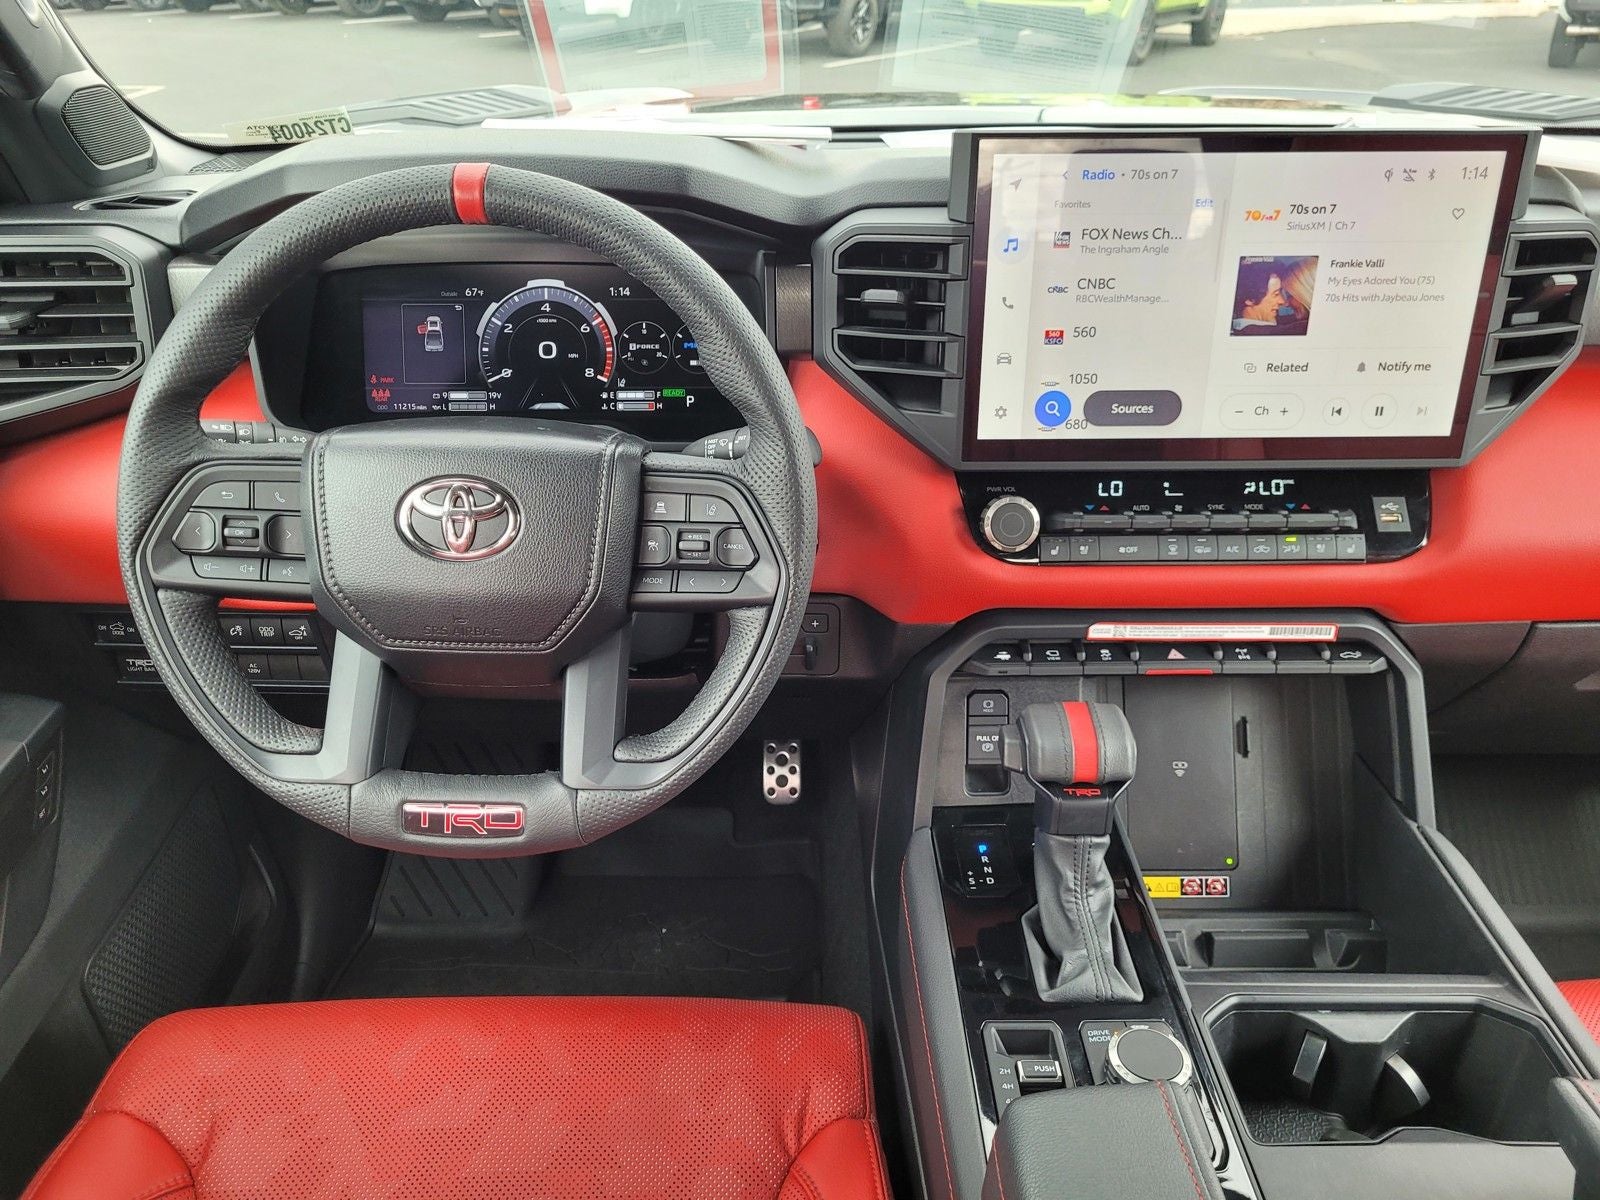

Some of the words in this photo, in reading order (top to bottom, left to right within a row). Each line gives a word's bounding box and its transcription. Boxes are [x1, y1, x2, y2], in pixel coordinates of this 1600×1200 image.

[1082, 169, 1115, 180] Radio
[1131, 169, 1150, 180] 70s
[1153, 171, 1168, 180] on
[1170, 169, 1179, 180] 7
[1461, 167, 1488, 180] 1:14
[1054, 199, 1091, 208] Favorites
[1195, 198, 1213, 207] Edit
[1290, 204, 1309, 215] 70s
[1311, 206, 1327, 215] on
[1329, 204, 1337, 215] 7
[1287, 221, 1325, 231] SiriusXM
[1335, 221, 1348, 231] Ch
[1350, 221, 1356, 231] 7
[1081, 229, 1109, 240] FOX
[1112, 228, 1148, 240] News
[1080, 245, 1096, 254] The
[1098, 245, 1140, 257] Ingraham
[1142, 245, 1169, 257] Angle
[1330, 259, 1363, 268] Frankie
[1365, 259, 1385, 268] Valli
[1077, 278, 1116, 290] CNBC
[1328, 276, 1341, 287] My
[1343, 276, 1362, 287] Eyes
[1363, 276, 1397, 285] Adored
[1399, 276, 1416, 285] You
[1417, 275, 1435, 286] (75)
[609, 287, 631, 297] 1:14
[1325, 293, 1341, 302] 70s
[1343, 293, 1360, 302] Hits
[1362, 293, 1381, 302] with
[1382, 293, 1418, 304] Jaybeau
[1418, 293, 1445, 303] Jones
[541, 303, 551, 313] 4
[504, 324, 513, 333] 2
[580, 323, 590, 333] 6
[1073, 326, 1096, 338] 560
[538, 341, 557, 359] 0
[585, 368, 594, 378] 8
[1266, 363, 1308, 373] Related
[1378, 361, 1412, 374] Notify
[1414, 364, 1431, 372] me
[1069, 373, 1098, 385] 1050
[686, 395, 695, 407] P
[1111, 403, 1154, 414] Sources
[1254, 406, 1269, 416] Ch
[1065, 419, 1088, 430] 680
[1098, 480, 1123, 496] LO
[1259, 479, 1284, 496] LO
[1064, 788, 1101, 798] TRD
[403, 803, 524, 834] TRD
[999, 1067, 1011, 1075] 2H
